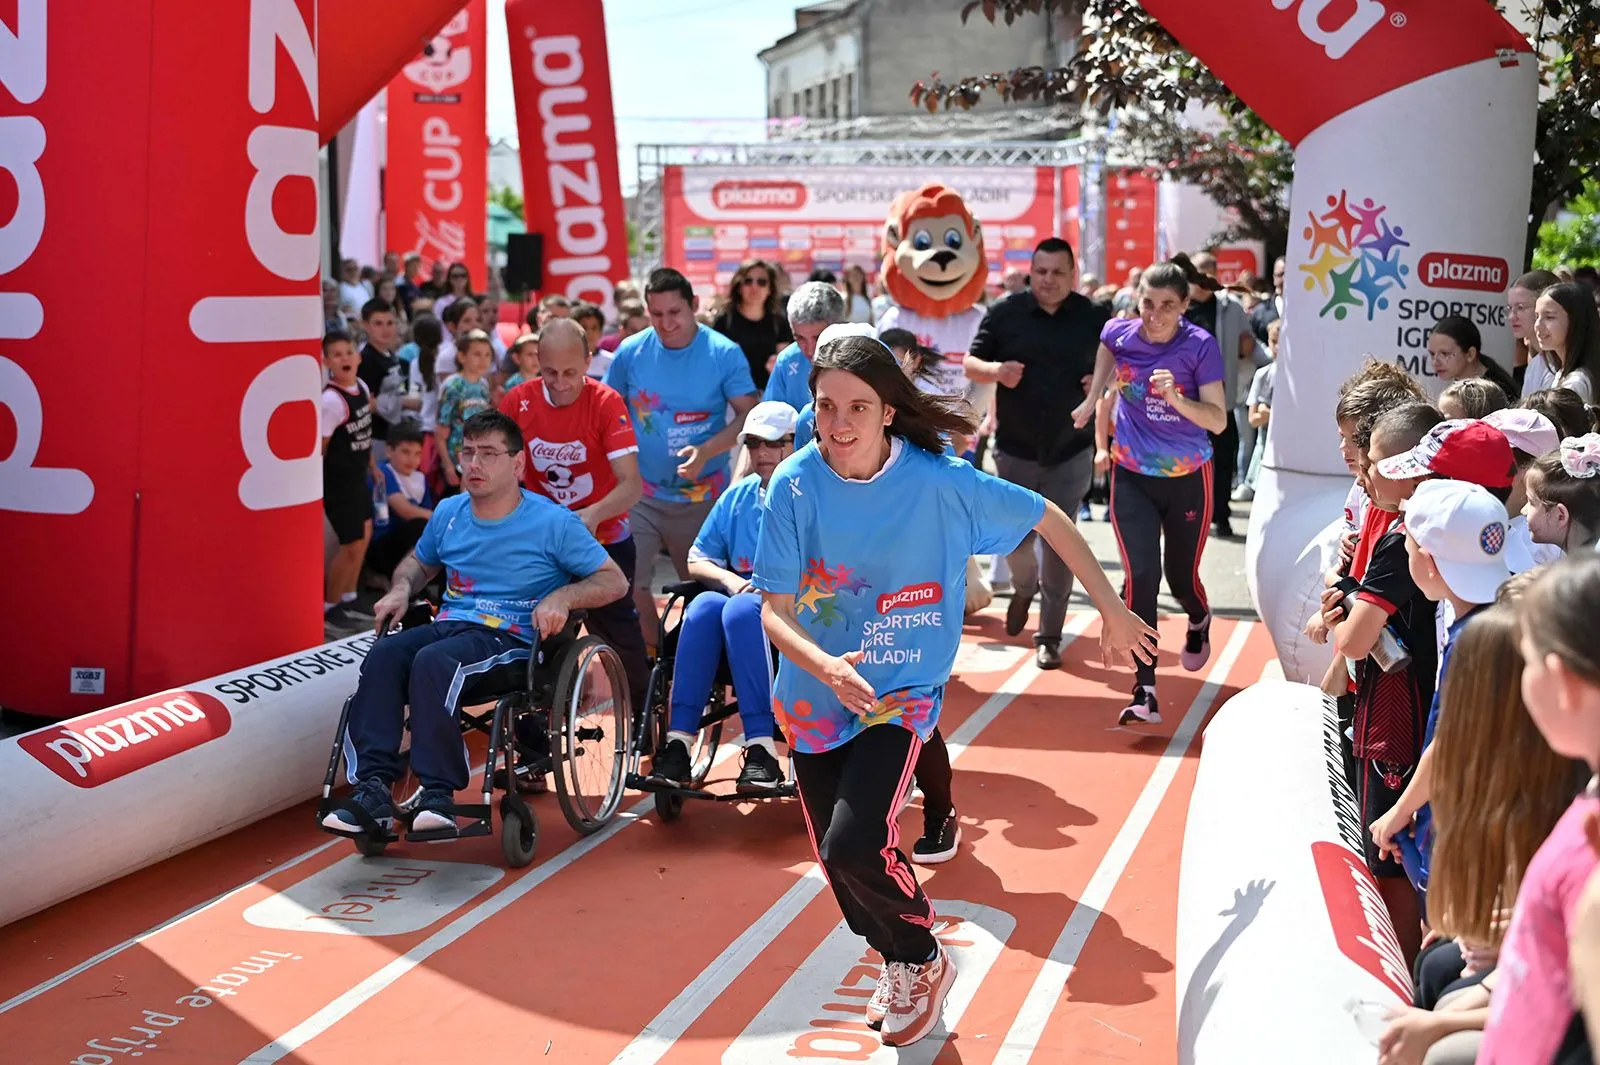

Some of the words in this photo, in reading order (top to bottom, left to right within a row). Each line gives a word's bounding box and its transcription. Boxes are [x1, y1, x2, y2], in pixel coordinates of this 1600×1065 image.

[423, 116, 463, 211] CUP
[718, 185, 797, 206] plazma
[1427, 258, 1502, 283] plazma
[1398, 298, 1506, 327] SPORTSKE
[1396, 355, 1439, 378] ML
[862, 611, 942, 636] SPORTSKE
[857, 649, 922, 665] MLADIH
[46, 698, 207, 778] plazma
[215, 648, 355, 704] SPORTSKE
[304, 866, 438, 923] m:tel
[175, 950, 303, 1008] imate
